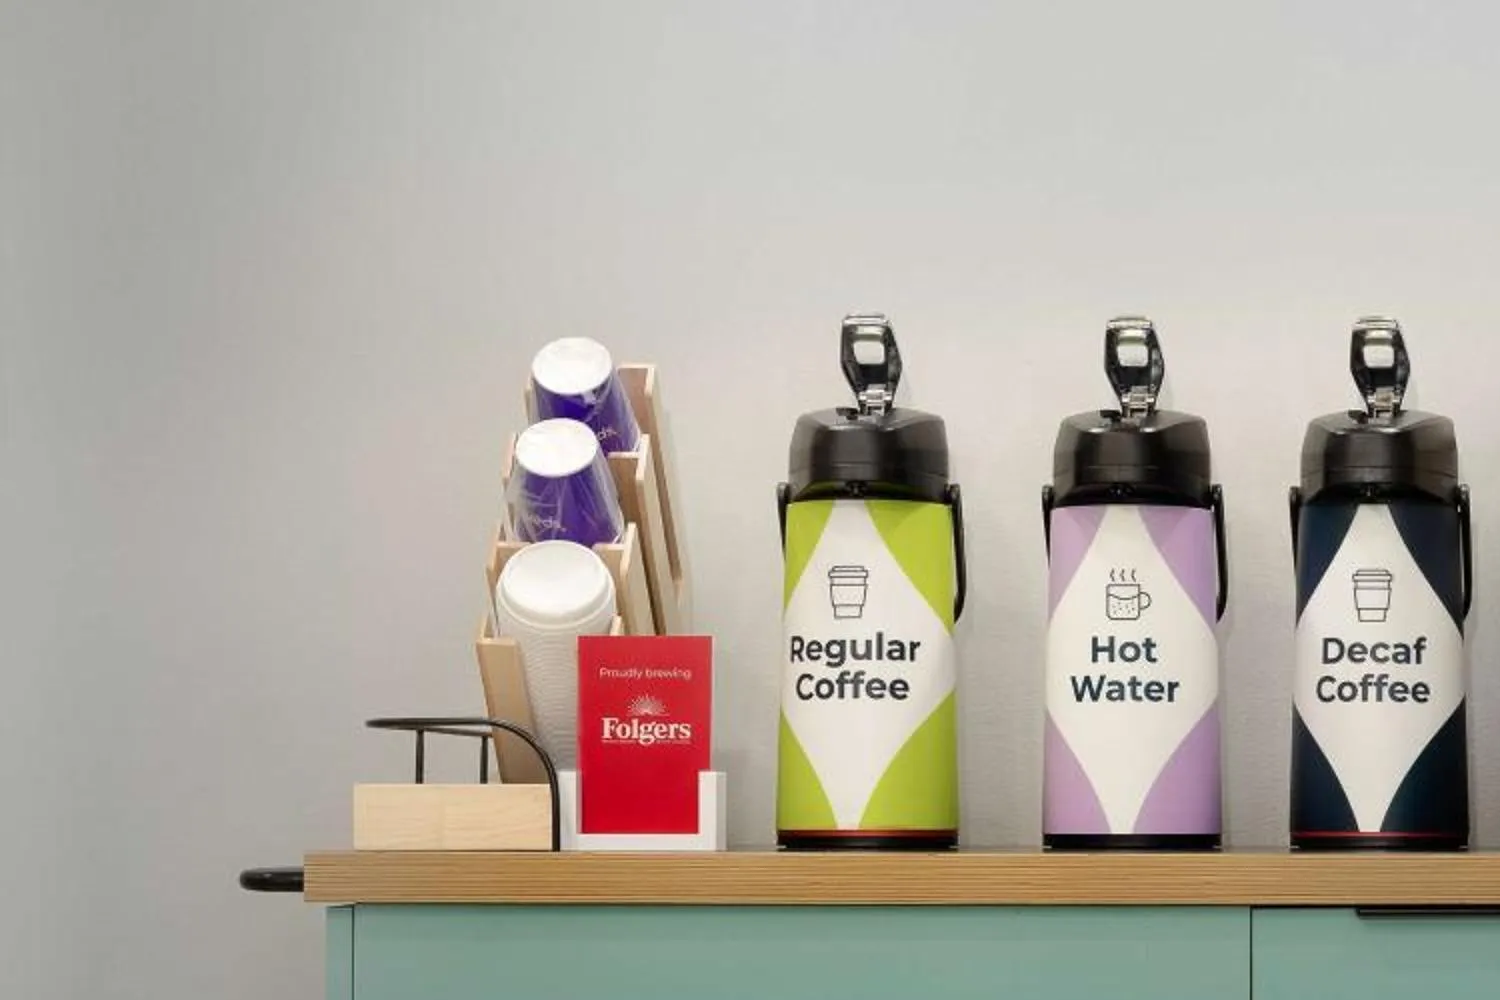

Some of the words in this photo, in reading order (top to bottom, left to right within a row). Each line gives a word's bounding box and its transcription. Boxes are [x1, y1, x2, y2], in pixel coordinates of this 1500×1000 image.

[790, 631, 921, 668] Regular
[1091, 636, 1158, 663] Hot
[1322, 636, 1427, 665] Decaf
[600, 667, 642, 679] Proudly
[645, 667, 692, 679] brewing
[796, 670, 910, 700] Coffee
[1070, 675, 1180, 703] Water
[1316, 674, 1431, 703] Coffee
[601, 717, 692, 745] Folgers
